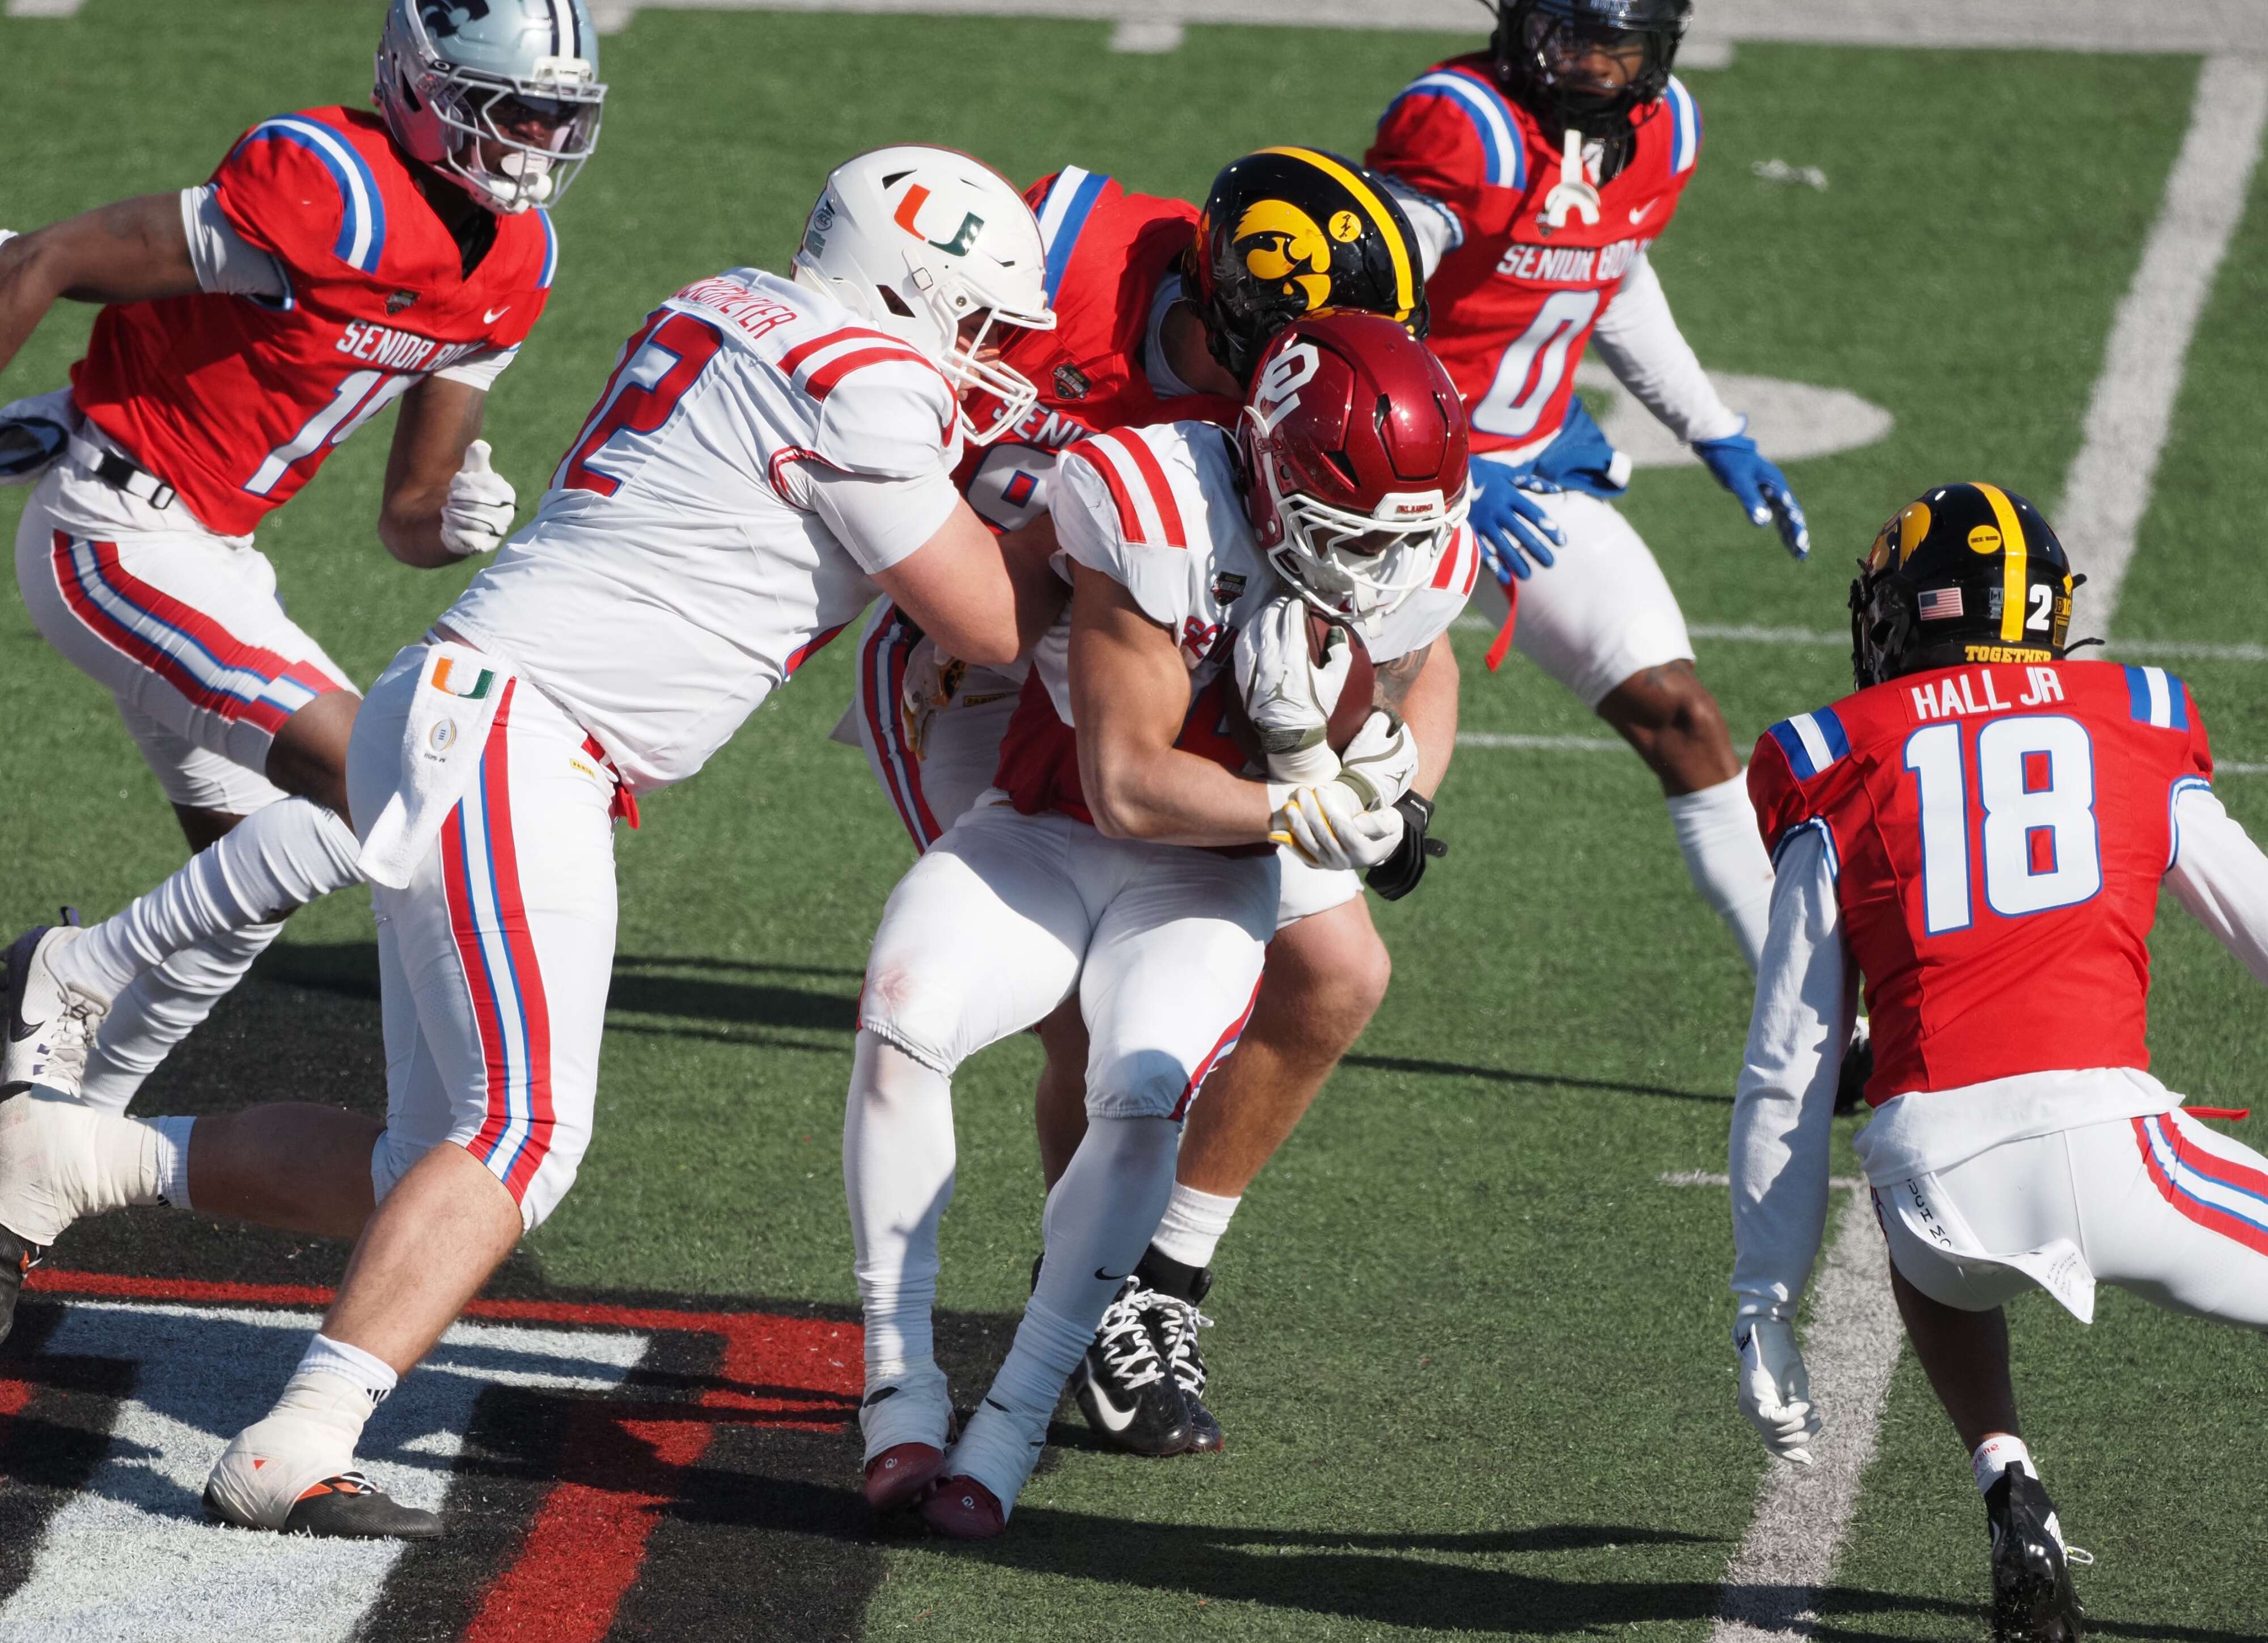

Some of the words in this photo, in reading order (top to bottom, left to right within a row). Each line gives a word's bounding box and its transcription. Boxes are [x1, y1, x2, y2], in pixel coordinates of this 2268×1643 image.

[1496, 244, 1597, 282] SENIOR
[335, 318, 436, 371] SENIOR
[1471, 289, 1601, 438] 0
[2026, 584, 2053, 631] 2
[1965, 645, 2051, 664] TOGETHER
[1911, 669, 2011, 720] HALL
[2020, 667, 2065, 706] JR
[1903, 715, 2103, 937] 18
